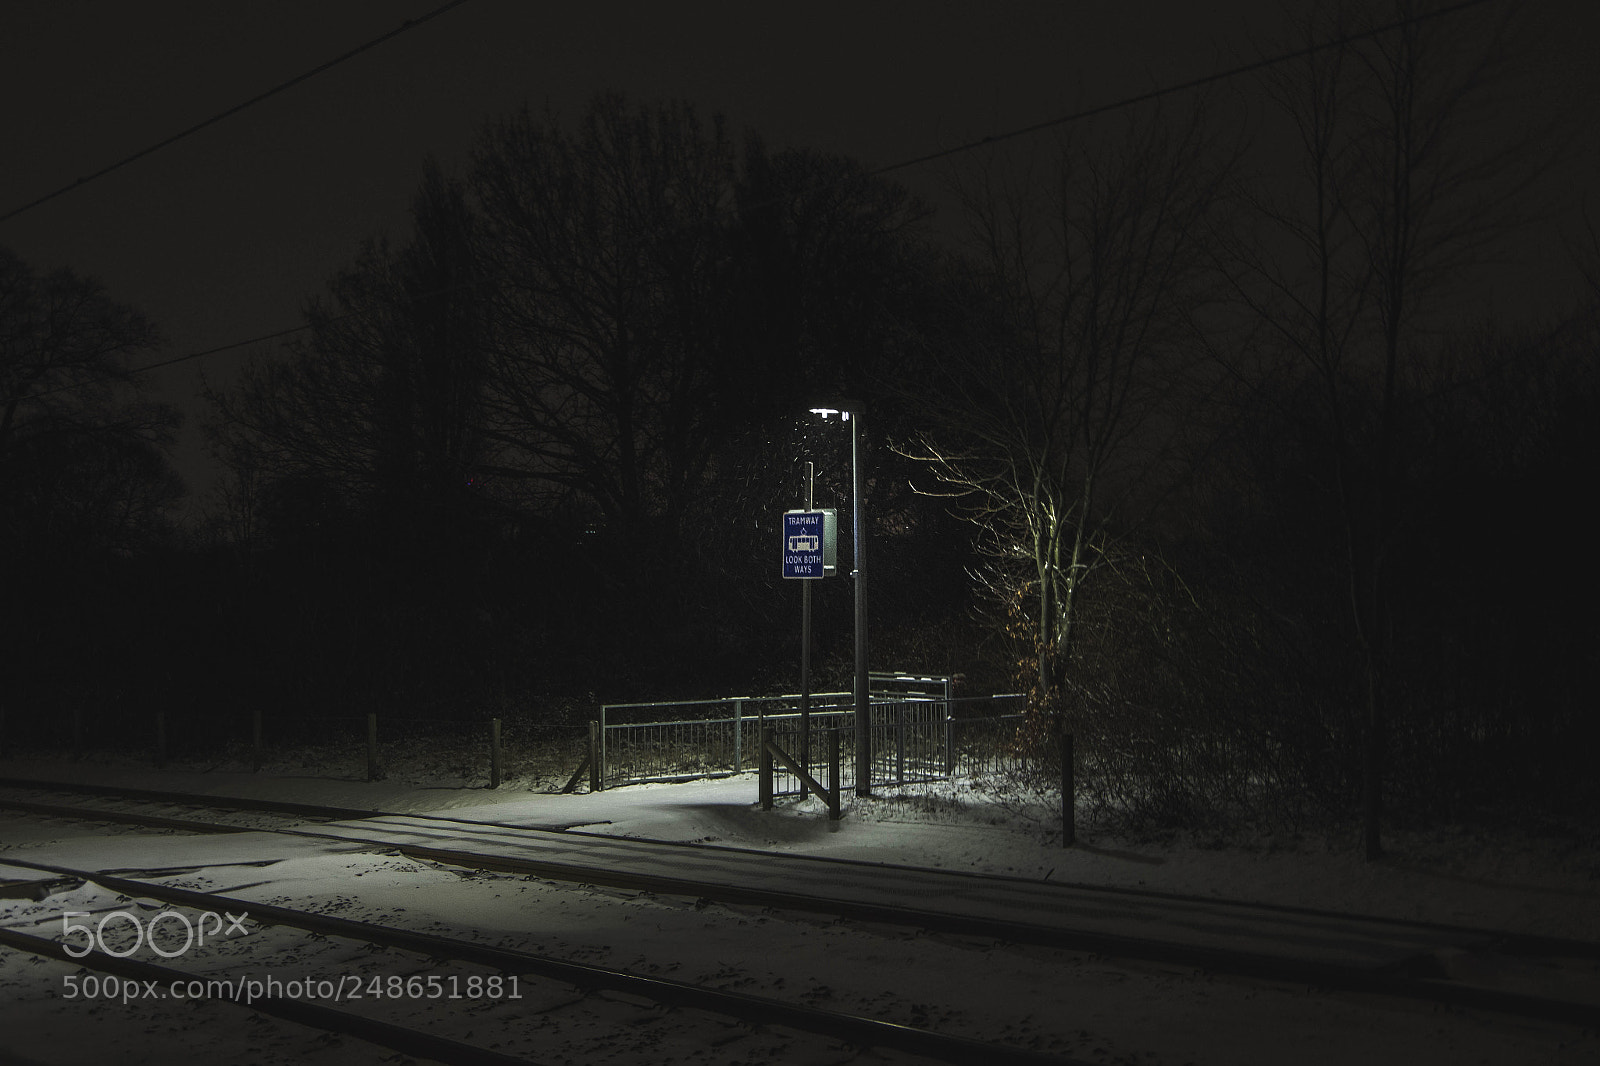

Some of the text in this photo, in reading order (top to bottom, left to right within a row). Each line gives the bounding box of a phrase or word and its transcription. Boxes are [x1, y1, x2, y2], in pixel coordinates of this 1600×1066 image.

[788, 516, 819, 525] TRAMWAY
[785, 555, 821, 564] LOOK BOTH
[794, 565, 812, 574] WAYS
